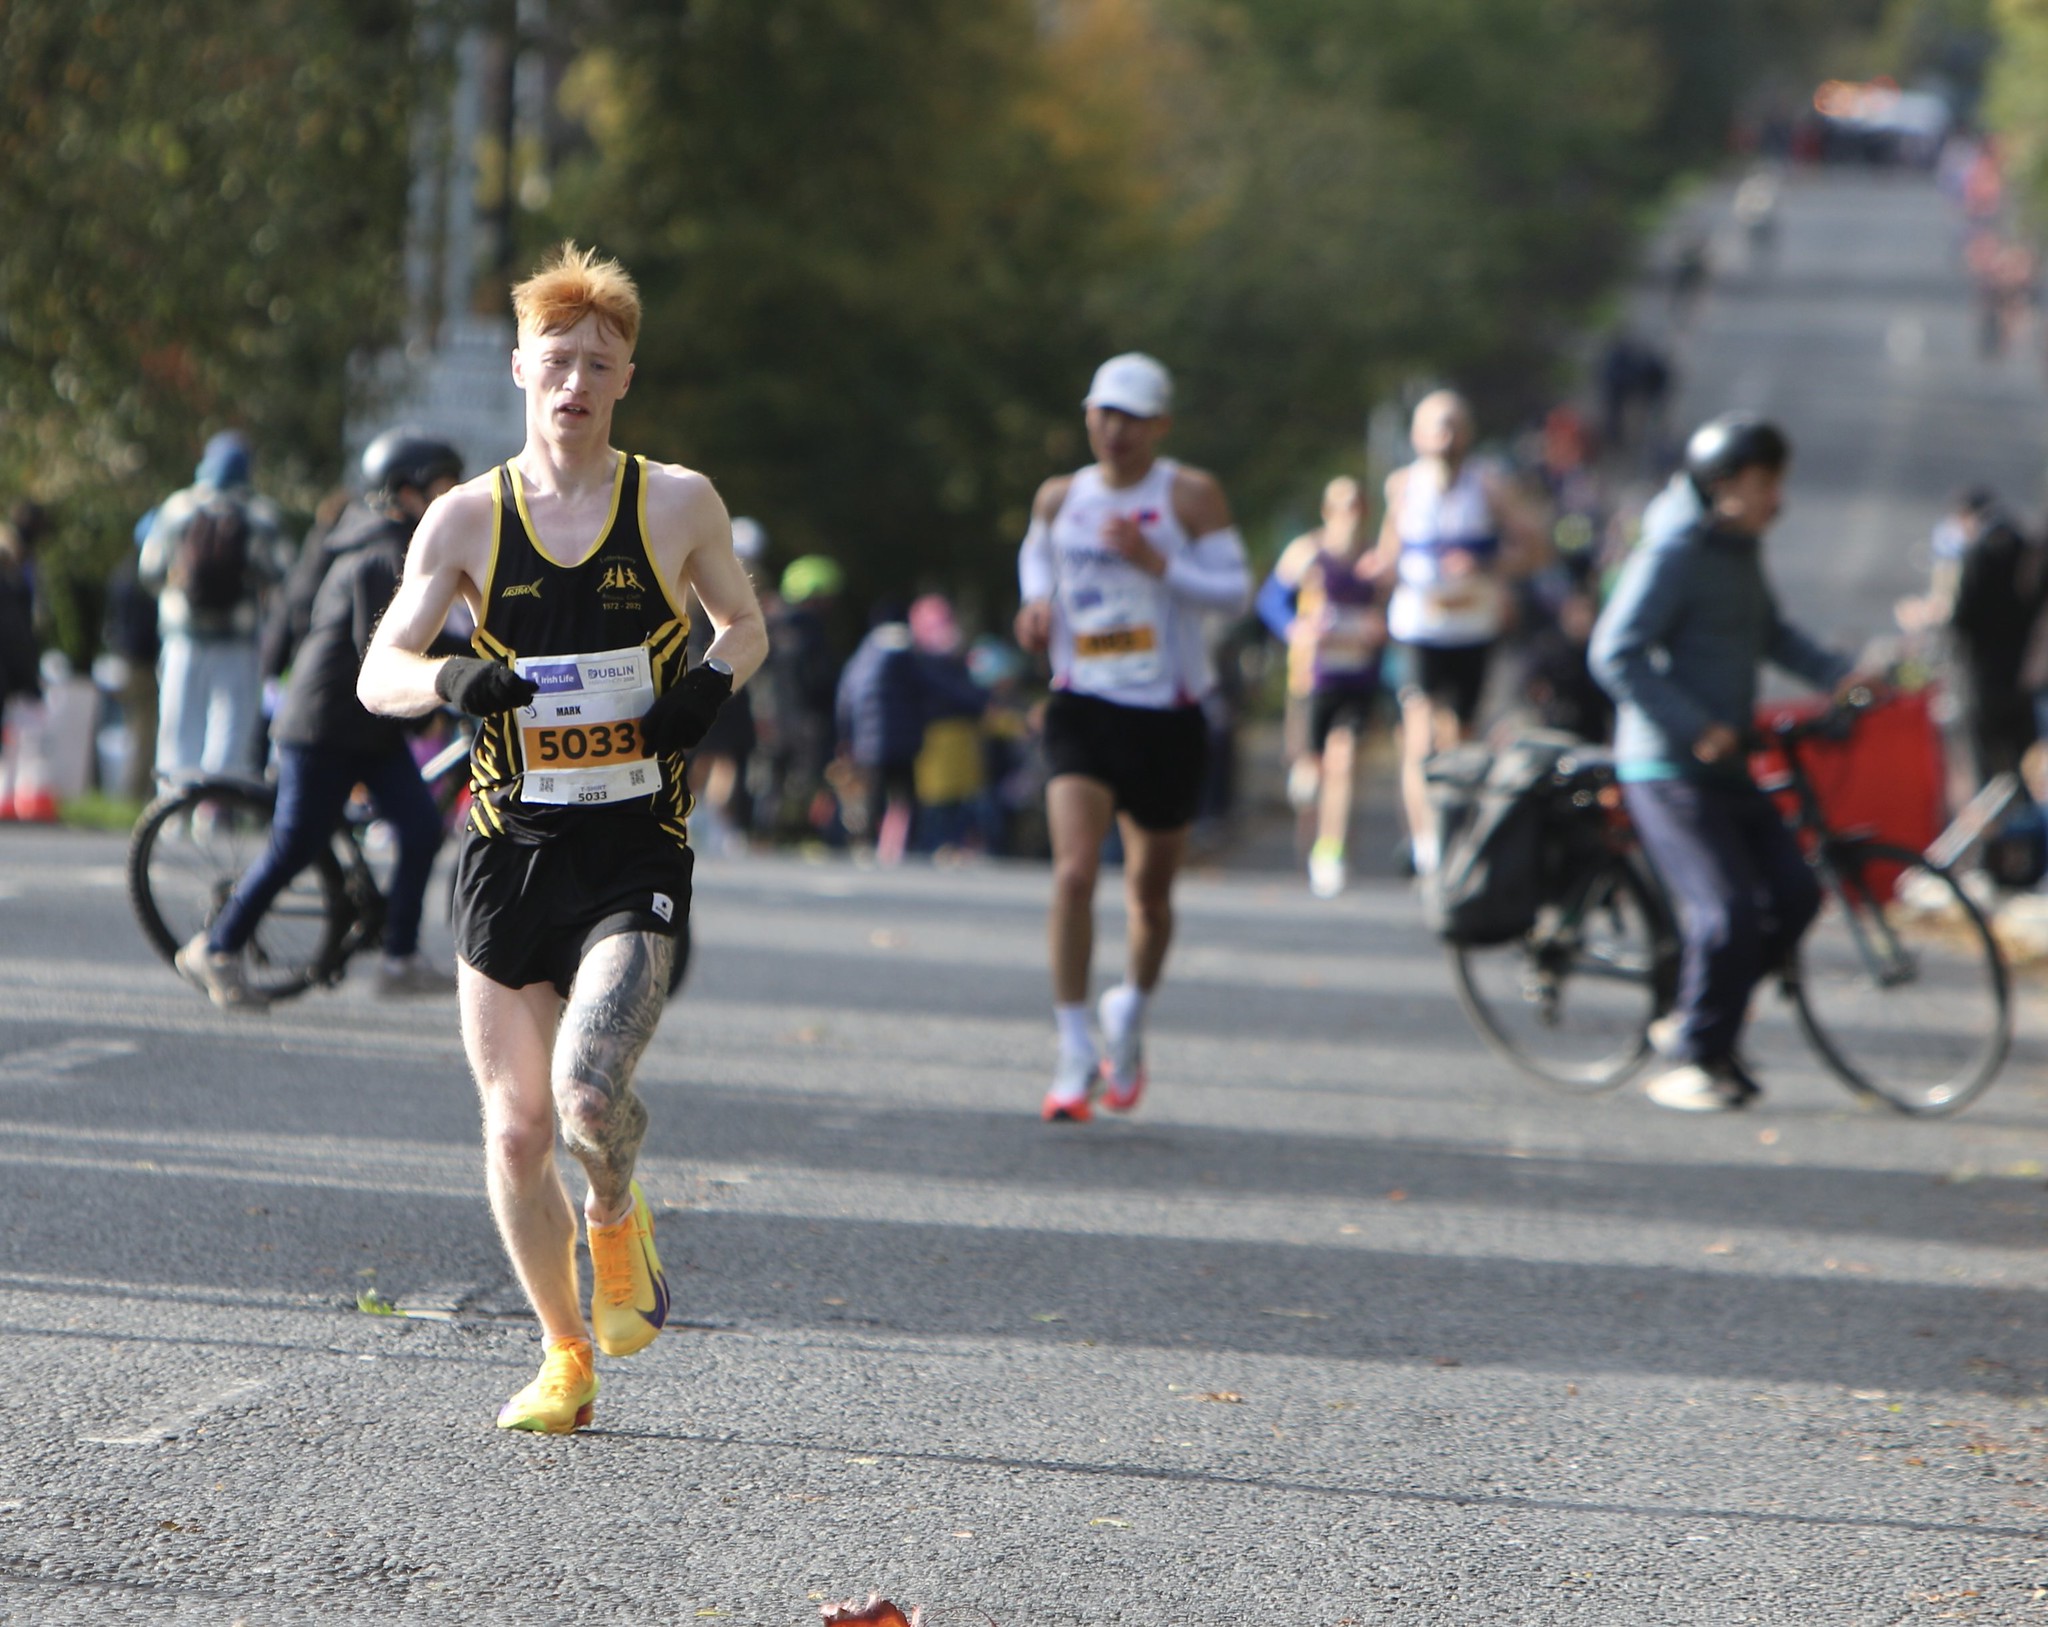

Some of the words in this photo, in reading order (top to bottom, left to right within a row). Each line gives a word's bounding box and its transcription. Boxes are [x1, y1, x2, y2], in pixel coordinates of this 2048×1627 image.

[587, 665, 634, 680] DUBLIN
[541, 674, 558, 685] Irish
[559, 674, 574, 683] Life
[556, 705, 581, 717] MARK
[539, 722, 636, 761] 5033
[578, 791, 607, 802] 5033
